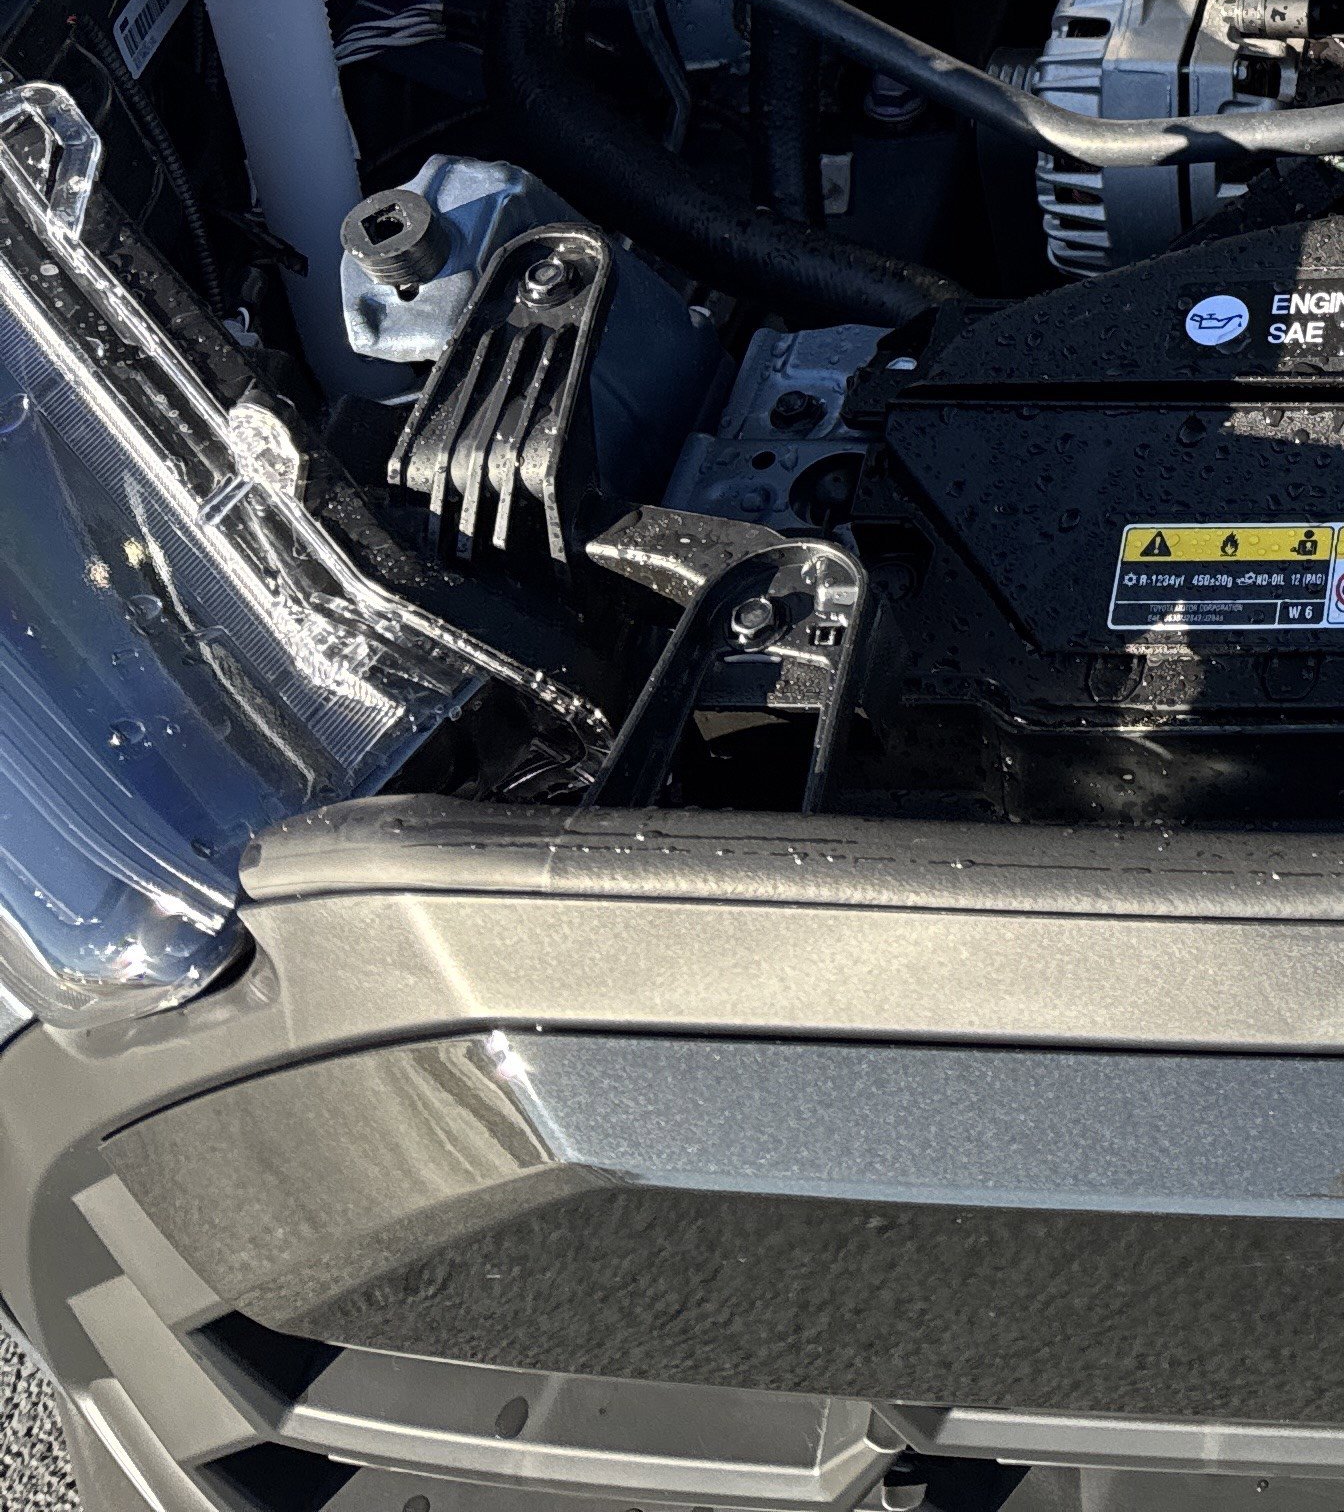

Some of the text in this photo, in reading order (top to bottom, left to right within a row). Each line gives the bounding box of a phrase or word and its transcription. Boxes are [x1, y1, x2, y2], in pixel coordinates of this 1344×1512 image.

[1267, 321, 1324, 343] SAE
[1139, 574, 1185, 588] R-1234yf
[1256, 574, 1285, 586] ND-OIL
[1290, 574, 1300, 585] 12
[1303, 574, 1325, 587] (PAG)
[1149, 604, 1174, 613] TOYOTA
[1199, 604, 1243, 612] CORPORATION
